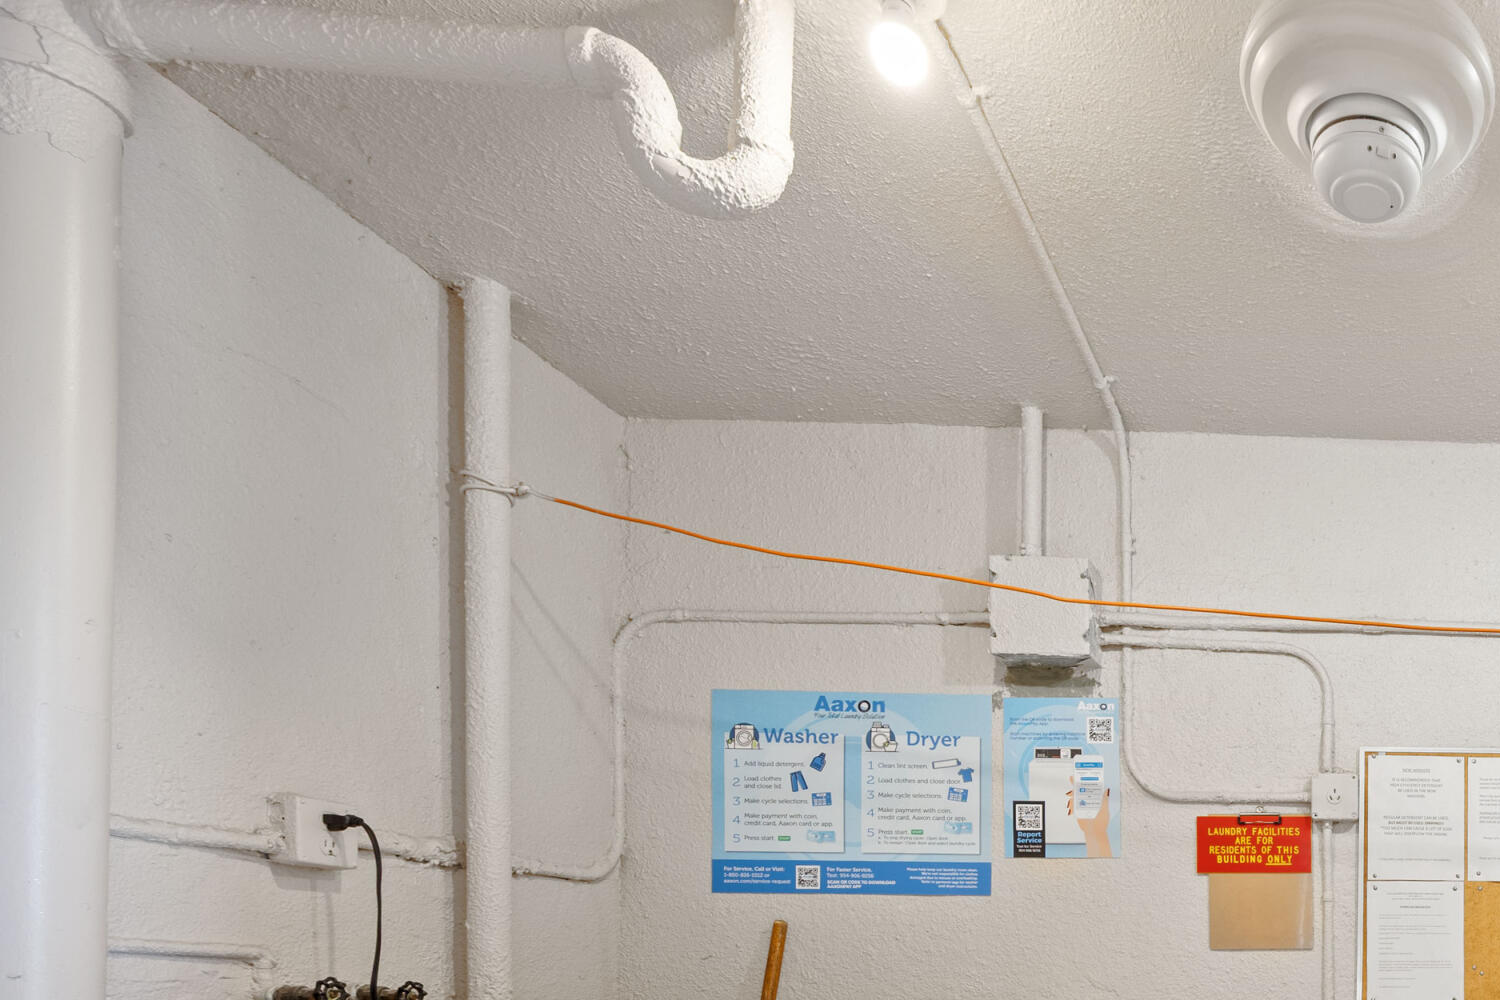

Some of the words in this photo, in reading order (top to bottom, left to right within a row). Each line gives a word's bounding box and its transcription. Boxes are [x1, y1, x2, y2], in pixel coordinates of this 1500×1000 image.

[814, 696, 886, 712] Aaxon
[1078, 701, 1114, 711] Aaxon
[763, 728, 839, 744] Washer
[906, 730, 961, 750] Dryer
[734, 758, 740, 768] 1
[867, 760, 874, 770] 1
[732, 777, 740, 787] 2
[866, 775, 875, 784] 2
[866, 790, 875, 800] 3
[732, 796, 740, 806] 3
[866, 808, 874, 817] 4
[732, 816, 740, 824] 4
[866, 828, 875, 838] 5
[1208, 828, 1247, 836] LAUNDRY
[1252, 828, 1300, 836] FACILITIES
[732, 833, 740, 843] 5
[1209, 846, 1256, 854] RESIDENTS
[1277, 846, 1300, 854] THIS
[1216, 855, 1262, 863] BUILDING
[1267, 855, 1292, 864] ONLY
